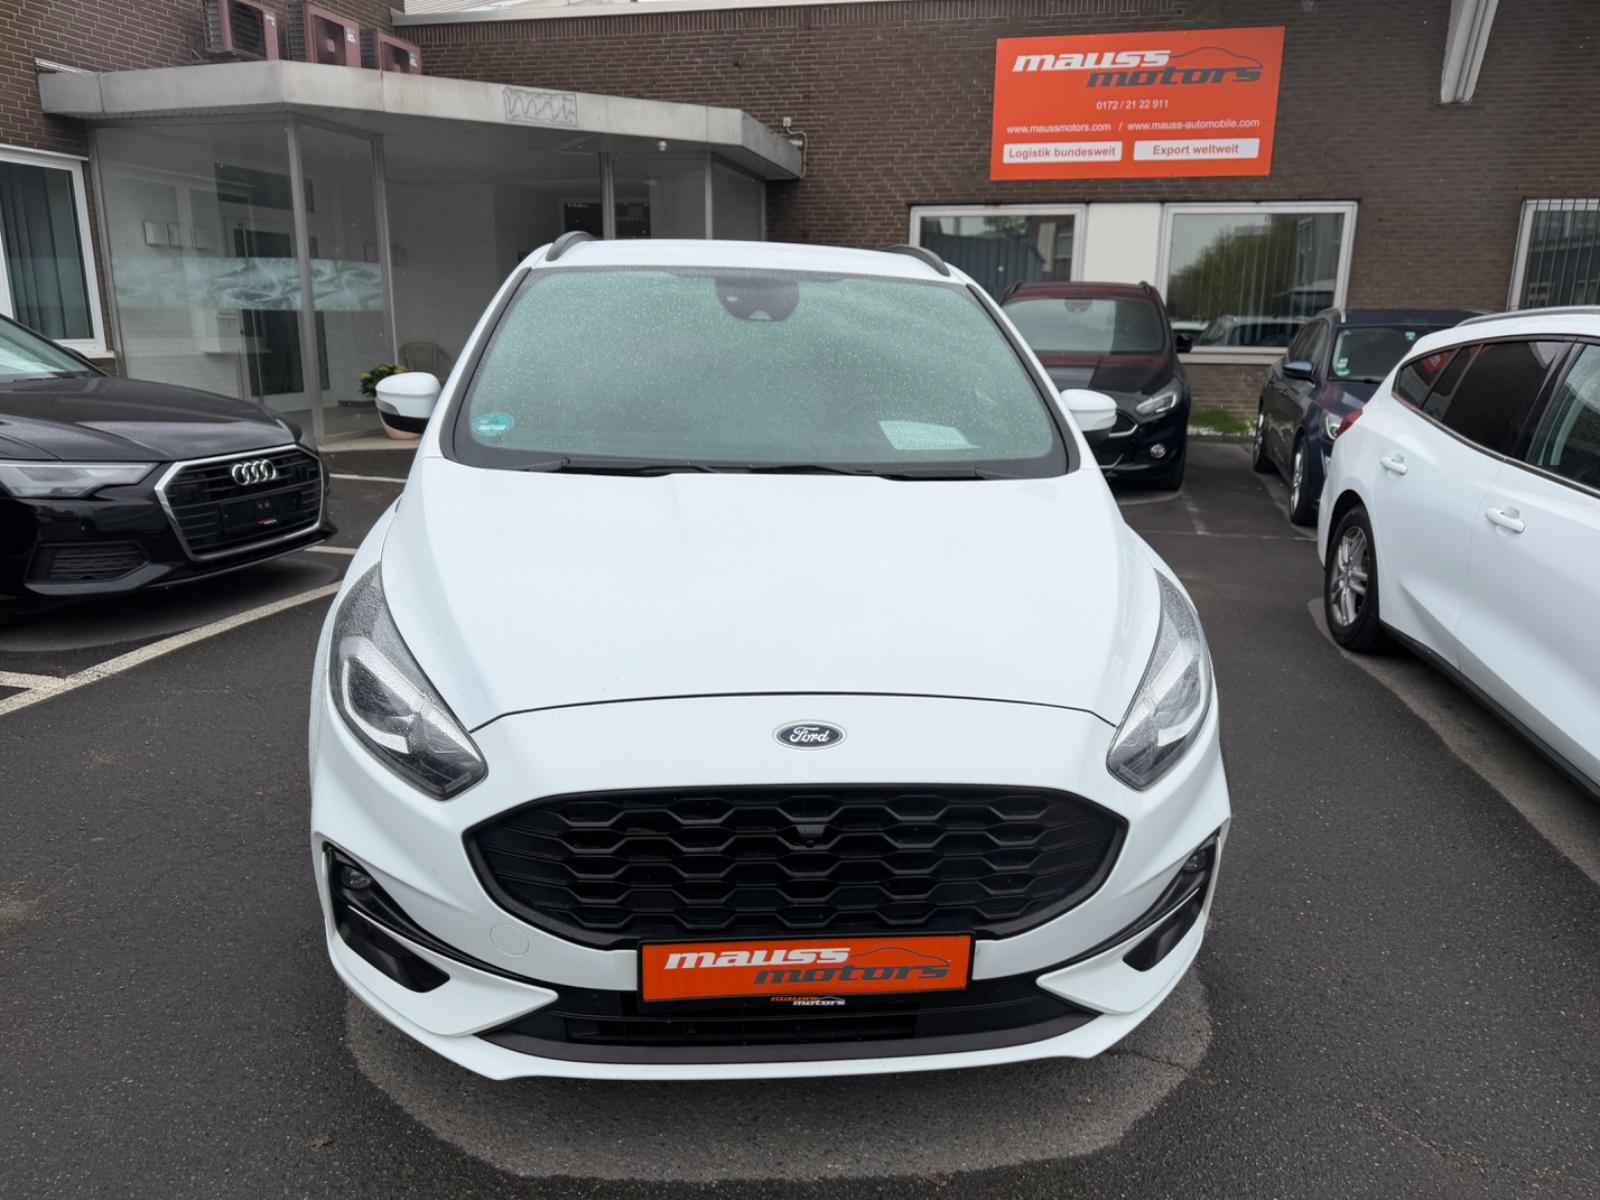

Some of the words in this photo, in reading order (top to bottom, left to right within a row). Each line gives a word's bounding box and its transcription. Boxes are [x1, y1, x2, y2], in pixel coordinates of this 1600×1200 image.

[1012, 50, 1171, 72] mauss
[1086, 66, 1262, 88] motors
[1096, 100, 1119, 110] 0172
[1125, 100, 1136, 109] 21
[1139, 100, 1150, 109] 22
[1152, 99, 1169, 109] 911
[1006, 123, 1111, 134] www.maussmotors.com
[1127, 118, 1260, 130] www.mauss-automobile.com
[1009, 148, 1051, 160] Logistik
[1054, 146, 1116, 158] bundesweit
[1153, 144, 1190, 157] Export
[1192, 143, 1239, 155] weltweit
[789, 726, 830, 742] Ford
[664, 947, 851, 970] mauss
[753, 963, 949, 985] motors
